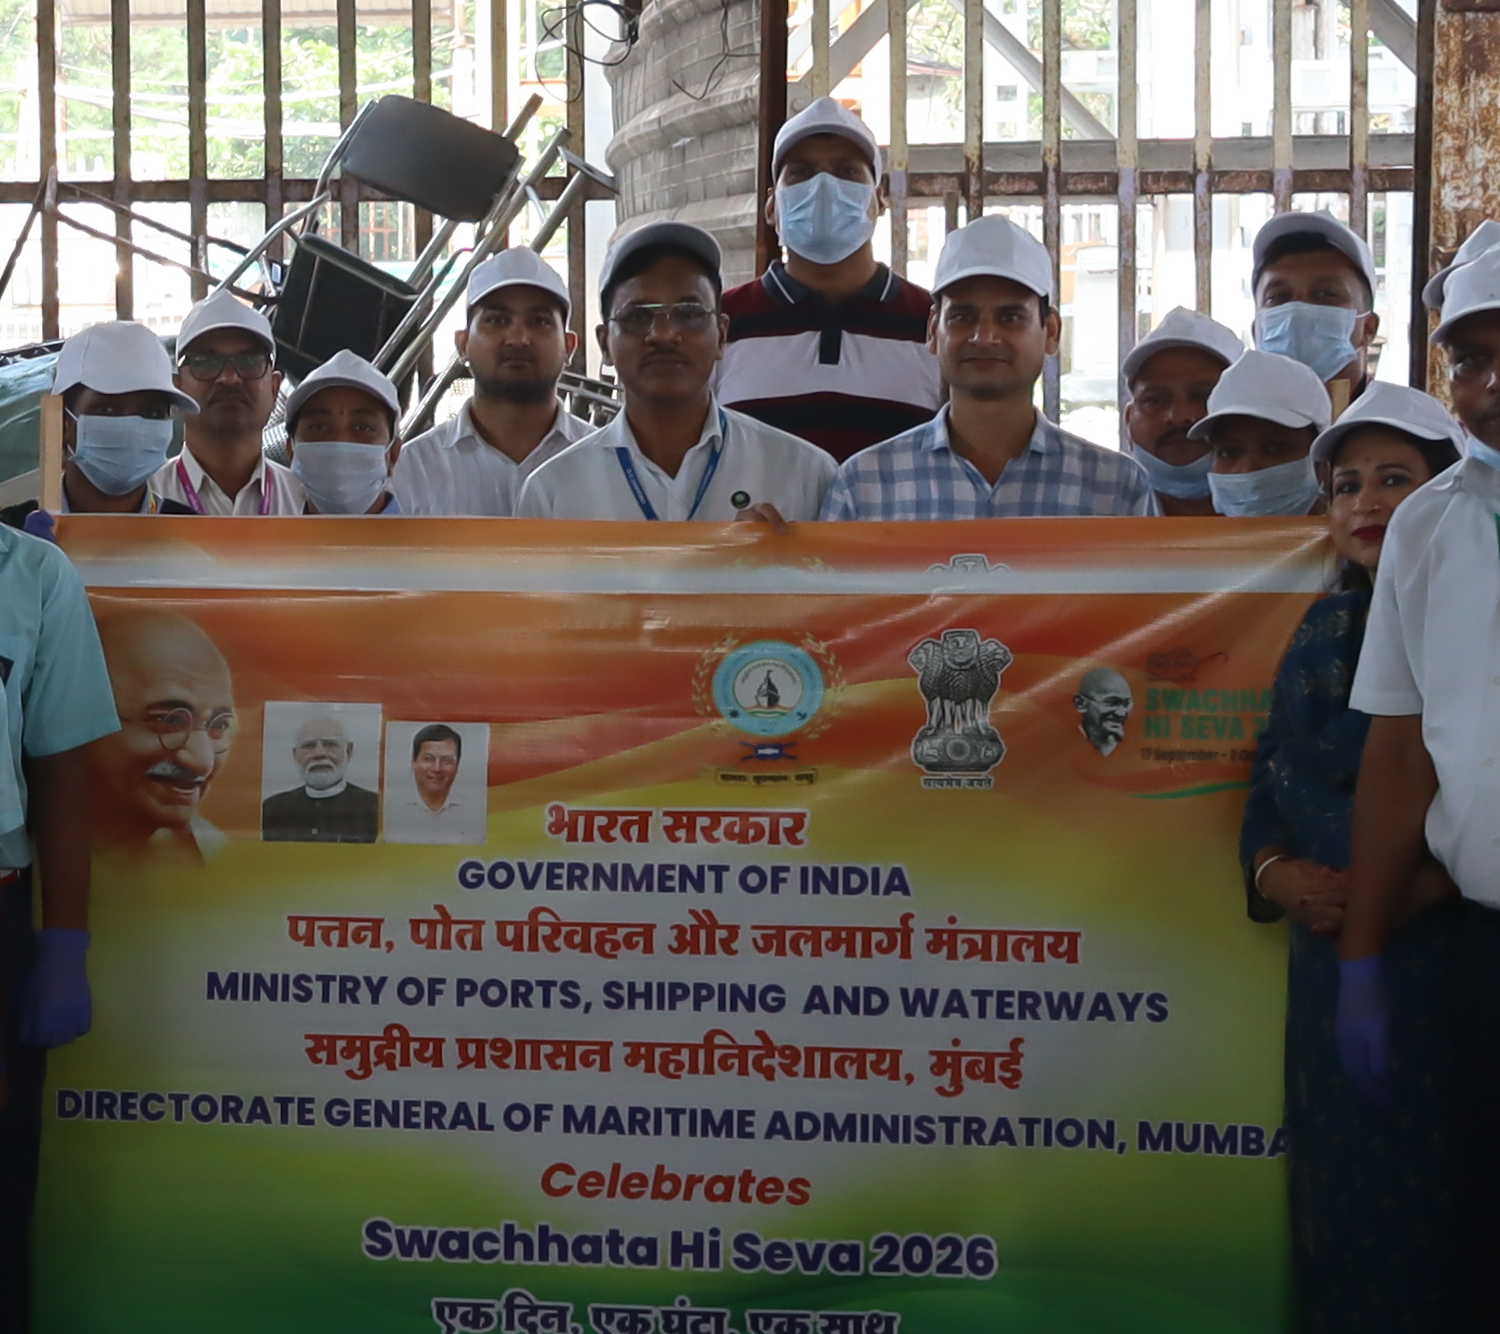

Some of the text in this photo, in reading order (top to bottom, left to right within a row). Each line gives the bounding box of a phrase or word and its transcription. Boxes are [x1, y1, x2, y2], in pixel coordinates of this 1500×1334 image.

[1144, 715, 1171, 740] HI
[1181, 715, 1245, 740] SEVA
[547, 805, 808, 846] भारत सरकार
[458, 861, 911, 897] GOVERNMENT OF INDIA
[287, 903, 1082, 965] पत्तन, पोत परिवहन और जलमार्ग मंत्रालय
[206, 971, 1170, 1023] MINISTRY OF PORTS, SHIPPING AND WATERWAYS
[304, 1023, 1025, 1098] समुद्रीय प्रशासन महानिदेशालय, मुंबई
[56, 1089, 315, 1127] DIRECTORATE
[325, 1098, 495, 1132] GENERAL
[503, 1102, 553, 1133] OF
[562, 1104, 756, 1139] MARITIME
[763, 1110, 1127, 1155] ADMINISTRATION,
[541, 1162, 812, 1206] Celebrates
[364, 1219, 996, 1277] Swachhata Hi Seva 2026
